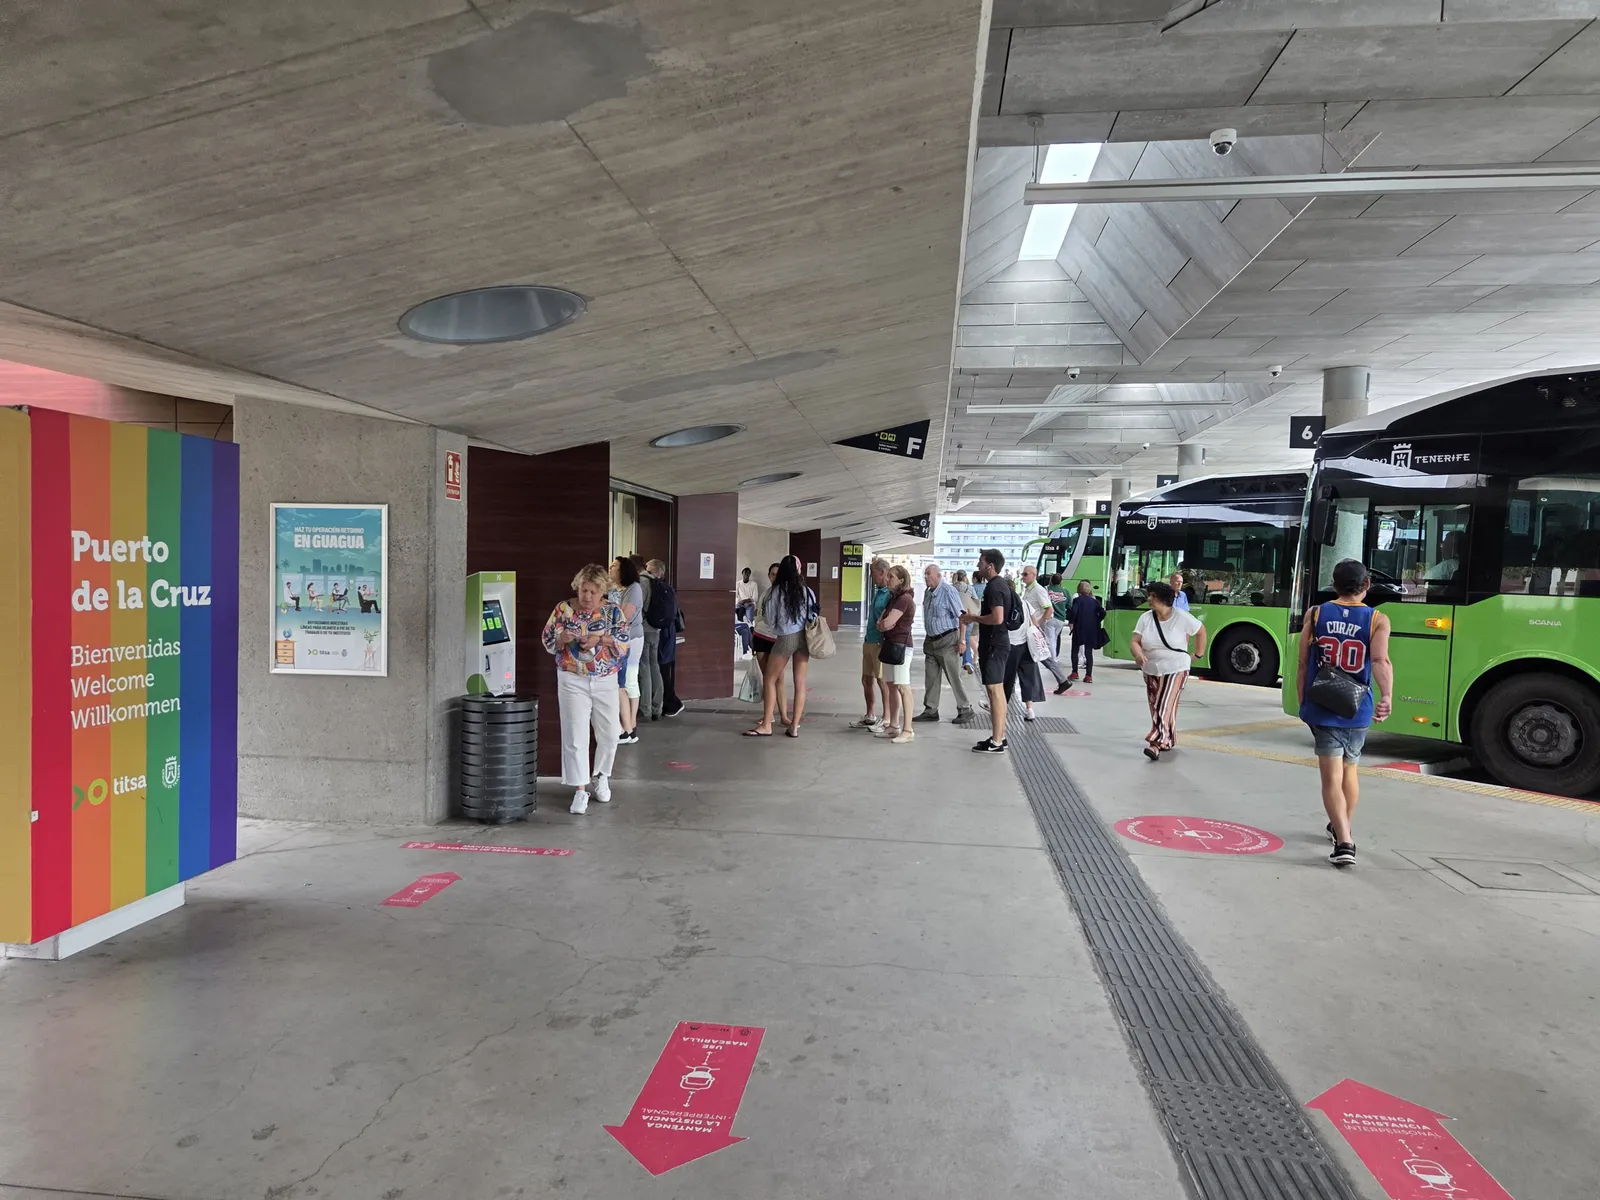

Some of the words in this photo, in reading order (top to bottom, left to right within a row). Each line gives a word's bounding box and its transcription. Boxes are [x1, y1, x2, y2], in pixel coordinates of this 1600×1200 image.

[1301, 425, 1313, 440] 6
[906, 436, 923, 455] F
[1414, 453, 1471, 463] TENERIFE
[920, 519, 927, 527] G
[71, 530, 169, 563] Puerto
[294, 534, 311, 548] EN
[312, 534, 365, 549] GUAGUA
[71, 580, 109, 612] de
[116, 579, 144, 610] la
[150, 578, 212, 608] Cruz
[1326, 620, 1362, 637] CURRY
[1528, 618, 1562, 627] SCANIA
[71, 638, 181, 667] Bienvenidas
[1317, 635, 1366, 674] 30
[70, 672, 155, 698] Welcome
[70, 697, 181, 730] Willkommen
[113, 774, 148, 795] titsa
[682, 1037, 748, 1047] MASCARILLA
[641, 1107, 727, 1120] INTERPERSONAL
[642, 1115, 702, 1125] DISTANCIA
[1343, 1112, 1416, 1123] MANTENGA
[647, 1122, 712, 1133] MANTENGA
[1343, 1124, 1442, 1139] INTERPERSONAL
[1362, 1120, 1431, 1131] DISTANCIA
